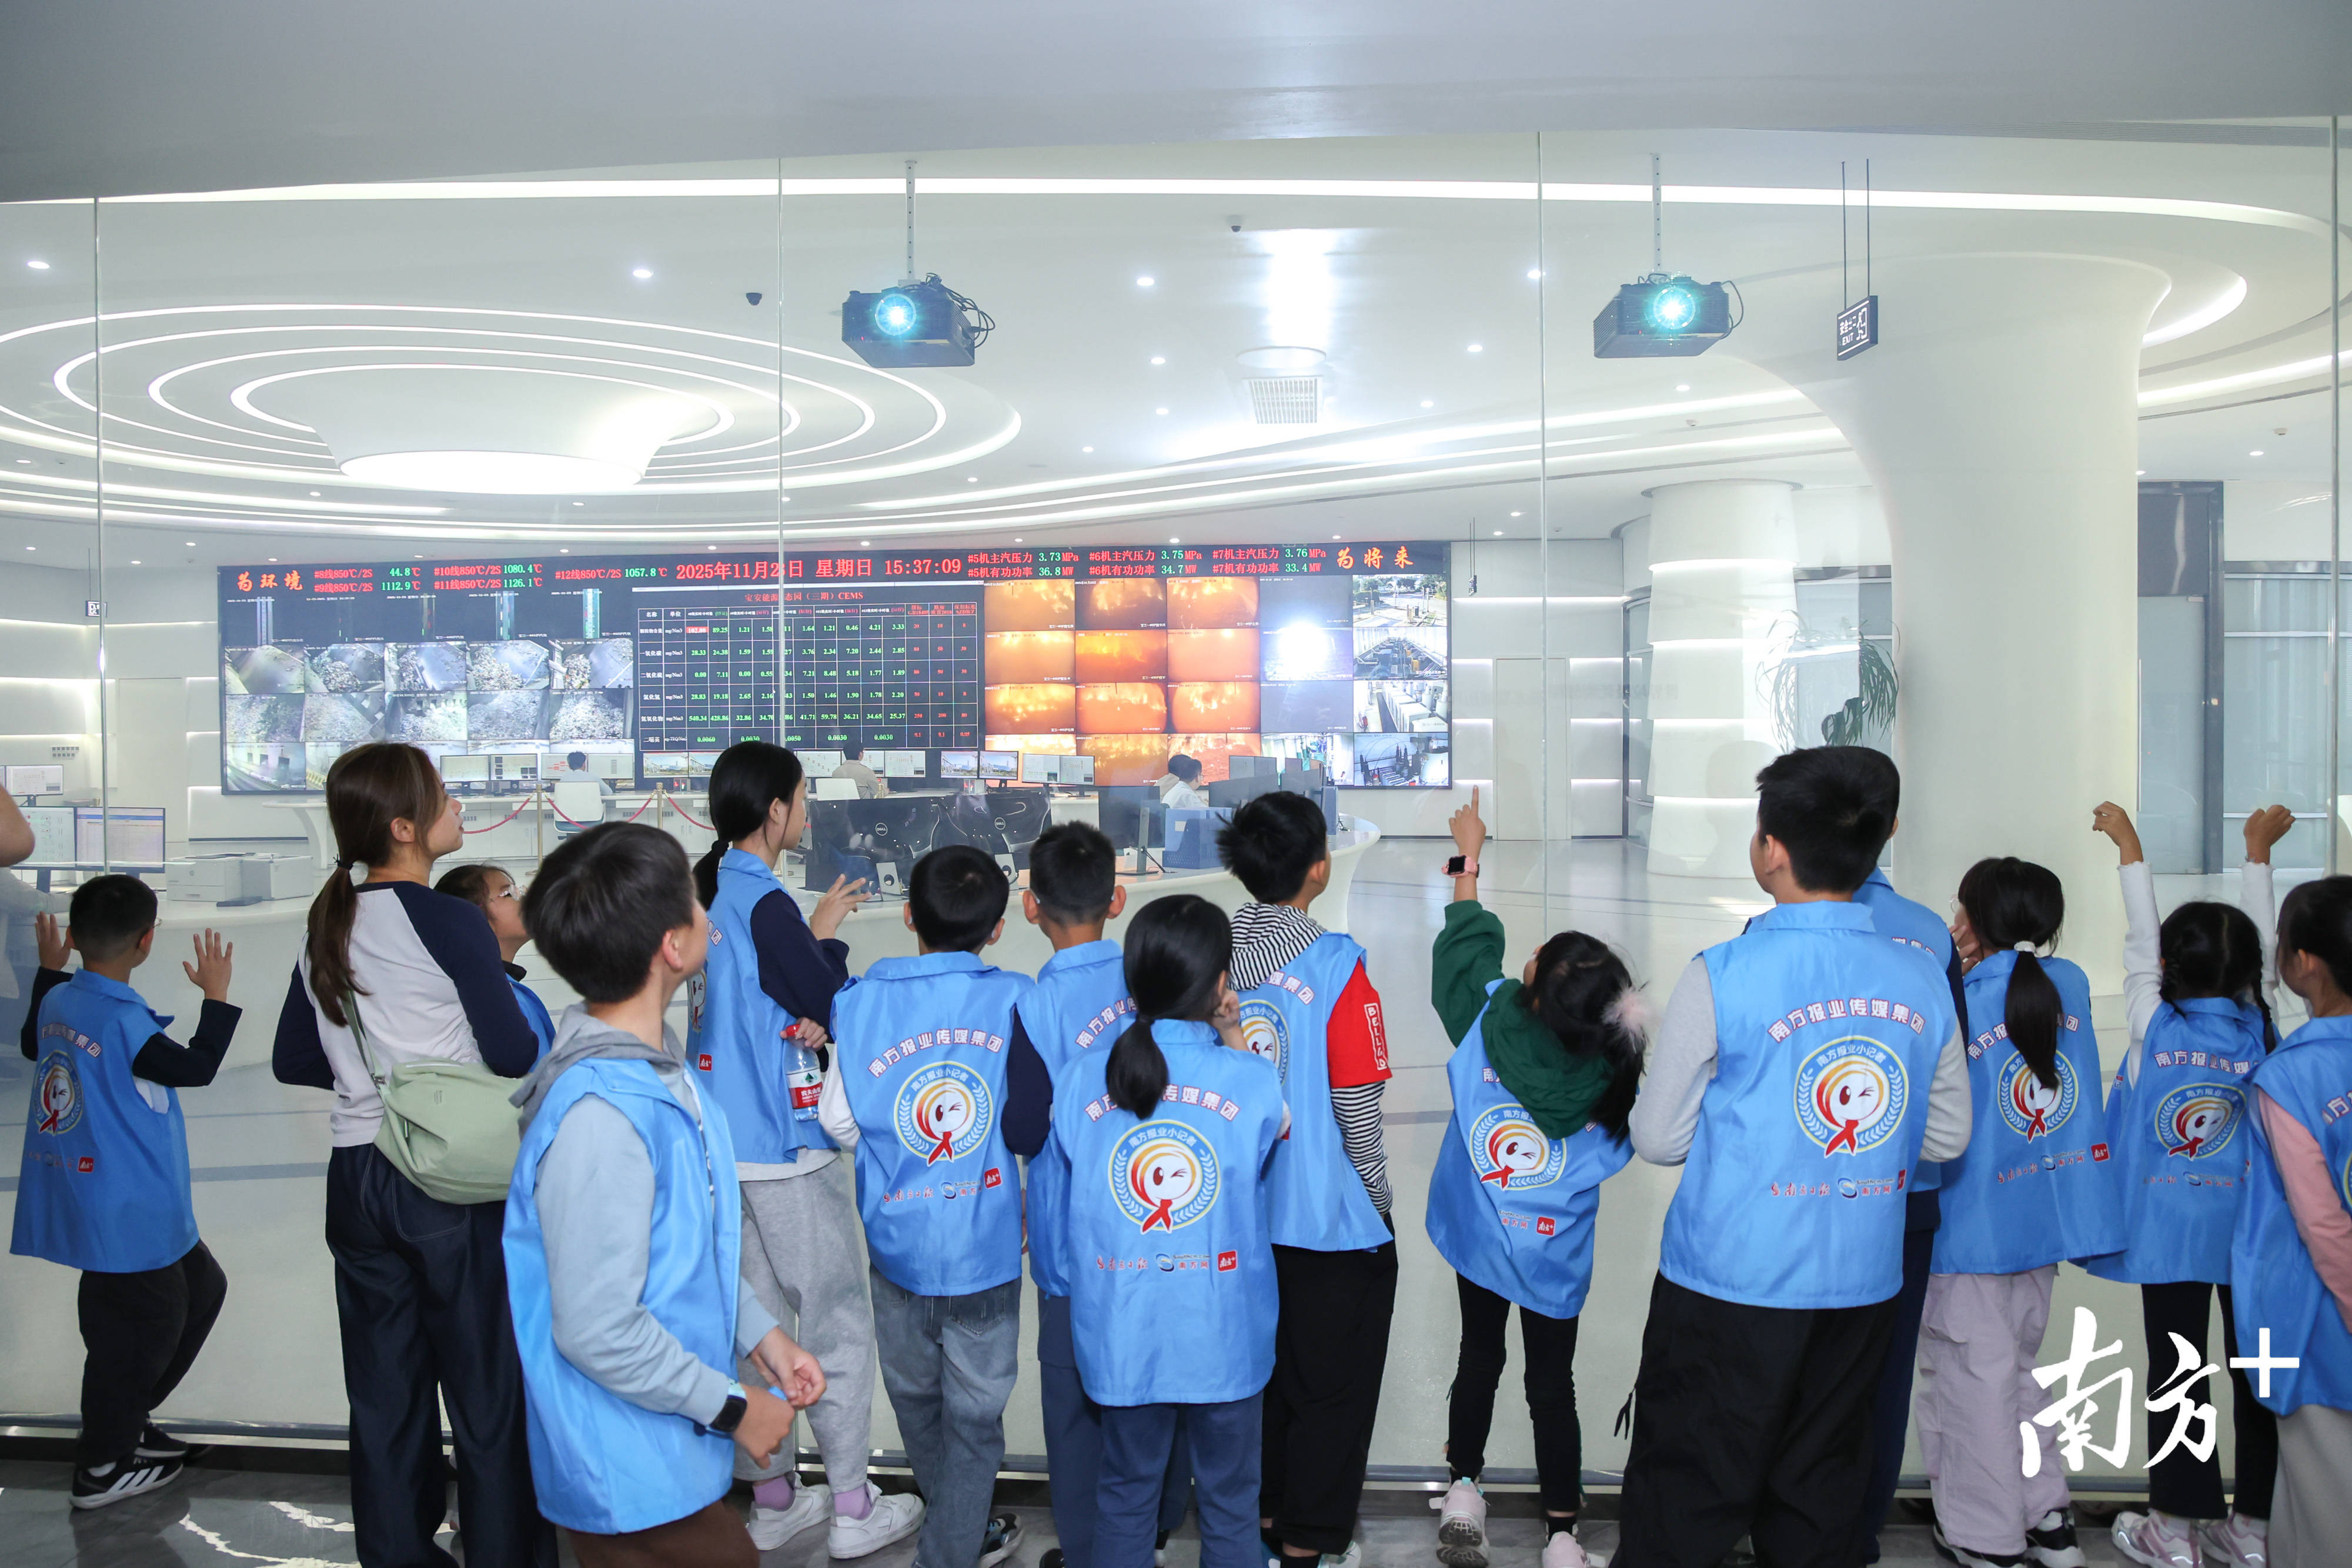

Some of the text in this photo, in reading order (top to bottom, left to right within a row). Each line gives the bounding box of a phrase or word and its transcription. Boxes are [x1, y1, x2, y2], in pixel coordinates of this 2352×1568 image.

[1842, 332, 1853, 346] EXIT
[968, 551, 1033, 564] #5机主汽压力
[1089, 550, 1155, 563] #6机主汽压力
[1212, 548, 1279, 560] #7机主汽压力
[816, 559, 872, 578] 星期日
[885, 559, 961, 575] 15:37:09
[968, 567, 1033, 579] #5机有功功率
[1089, 565, 1155, 576] #6机有功功率
[1212, 563, 1279, 574] #7机有功功率
[1768, 998, 1926, 1044] 南方报业传媒集团
[868, 1028, 1004, 1078] 南方报业传媒集团
[1816, 1044, 1887, 1067] 南方报业小记者
[911, 1068, 969, 1091] 南方报业小记者
[1128, 1126, 1197, 1148] 南方报业小记者
